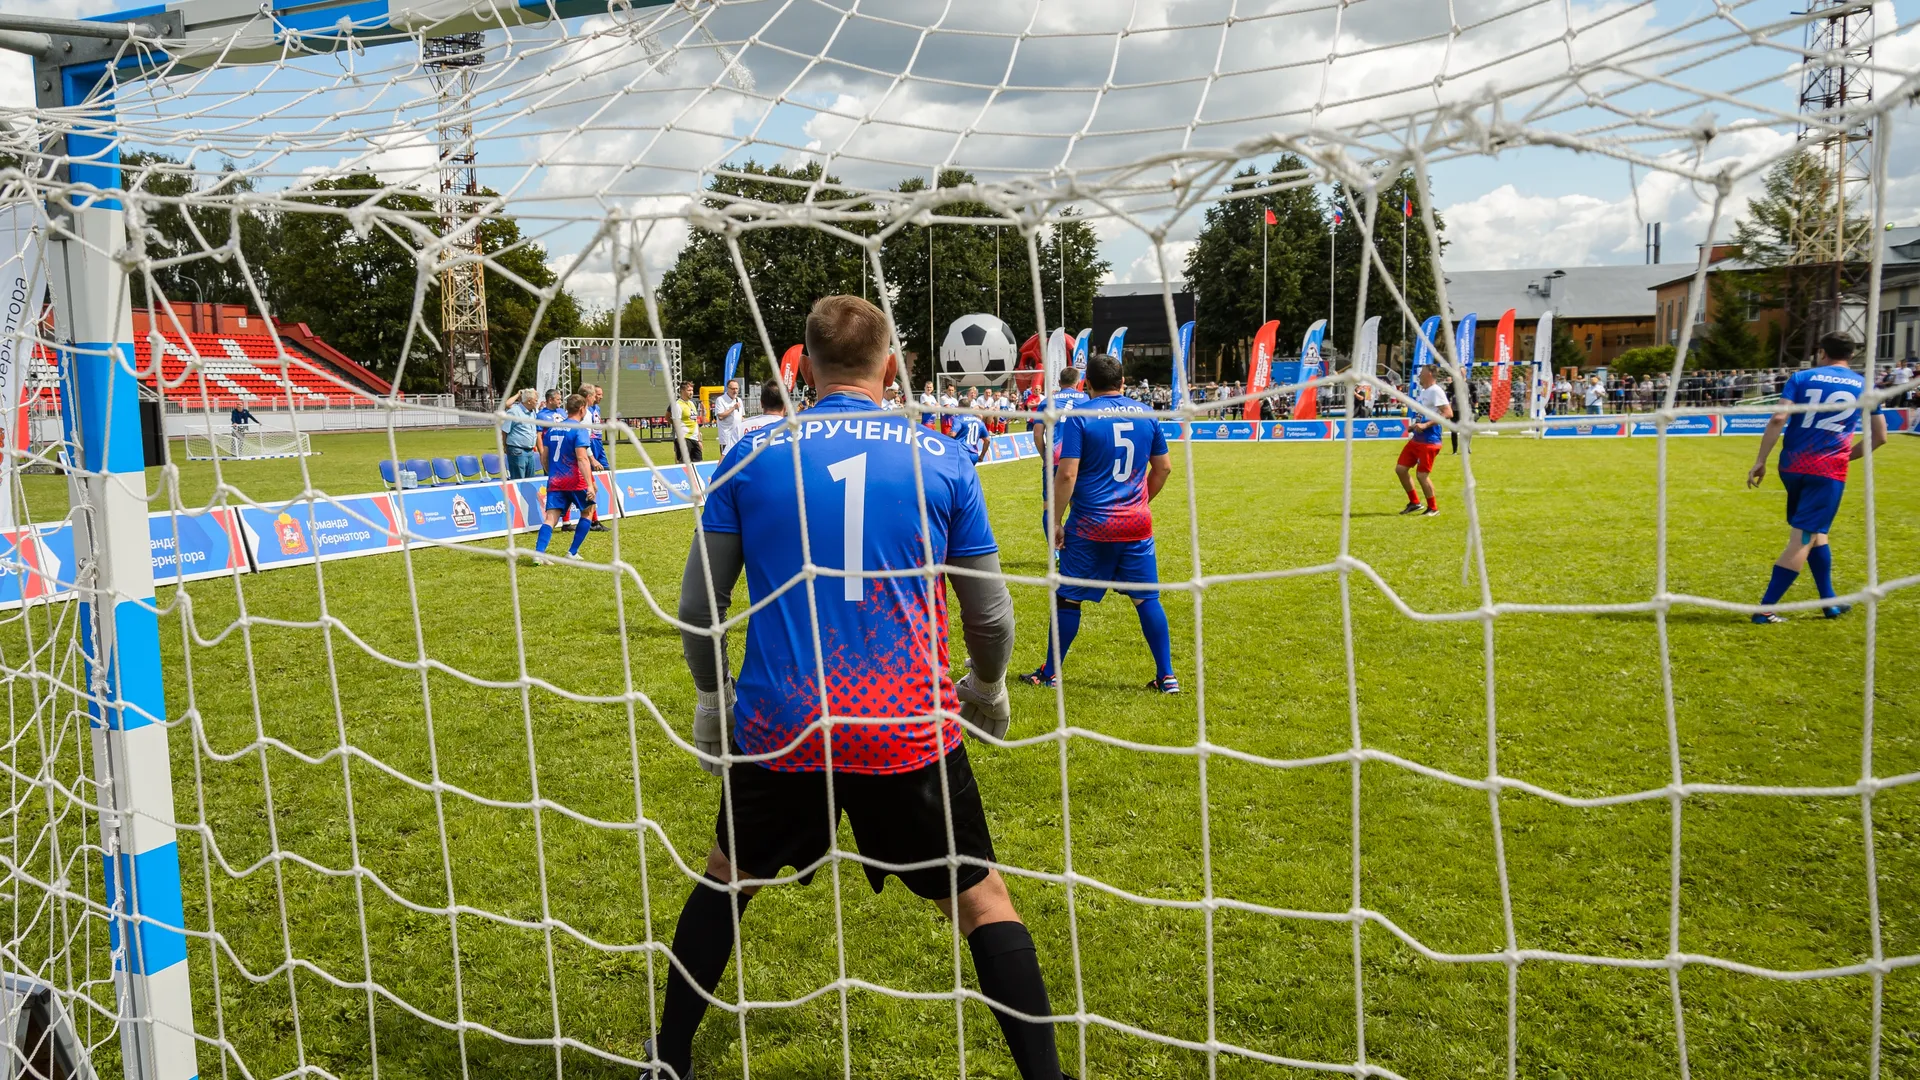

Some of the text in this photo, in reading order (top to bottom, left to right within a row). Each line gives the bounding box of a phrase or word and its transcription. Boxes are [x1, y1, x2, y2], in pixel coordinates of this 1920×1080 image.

[0, 277, 27, 400] ернатора
[1253, 342, 1265, 386] МОСОБЛ
[1260, 352, 1270, 387] СПОРТ
[1809, 374, 1862, 388] АВДОХИН
[1801, 388, 1856, 433] 12
[550, 435, 565, 462] 7
[752, 420, 946, 456] БЕЗРУЧЕНКО
[967, 422, 979, 446] 10
[1112, 422, 1135, 482] 5
[150, 537, 177, 550] анда
[827, 452, 868, 602] 1
[151, 551, 206, 568] ернатора
